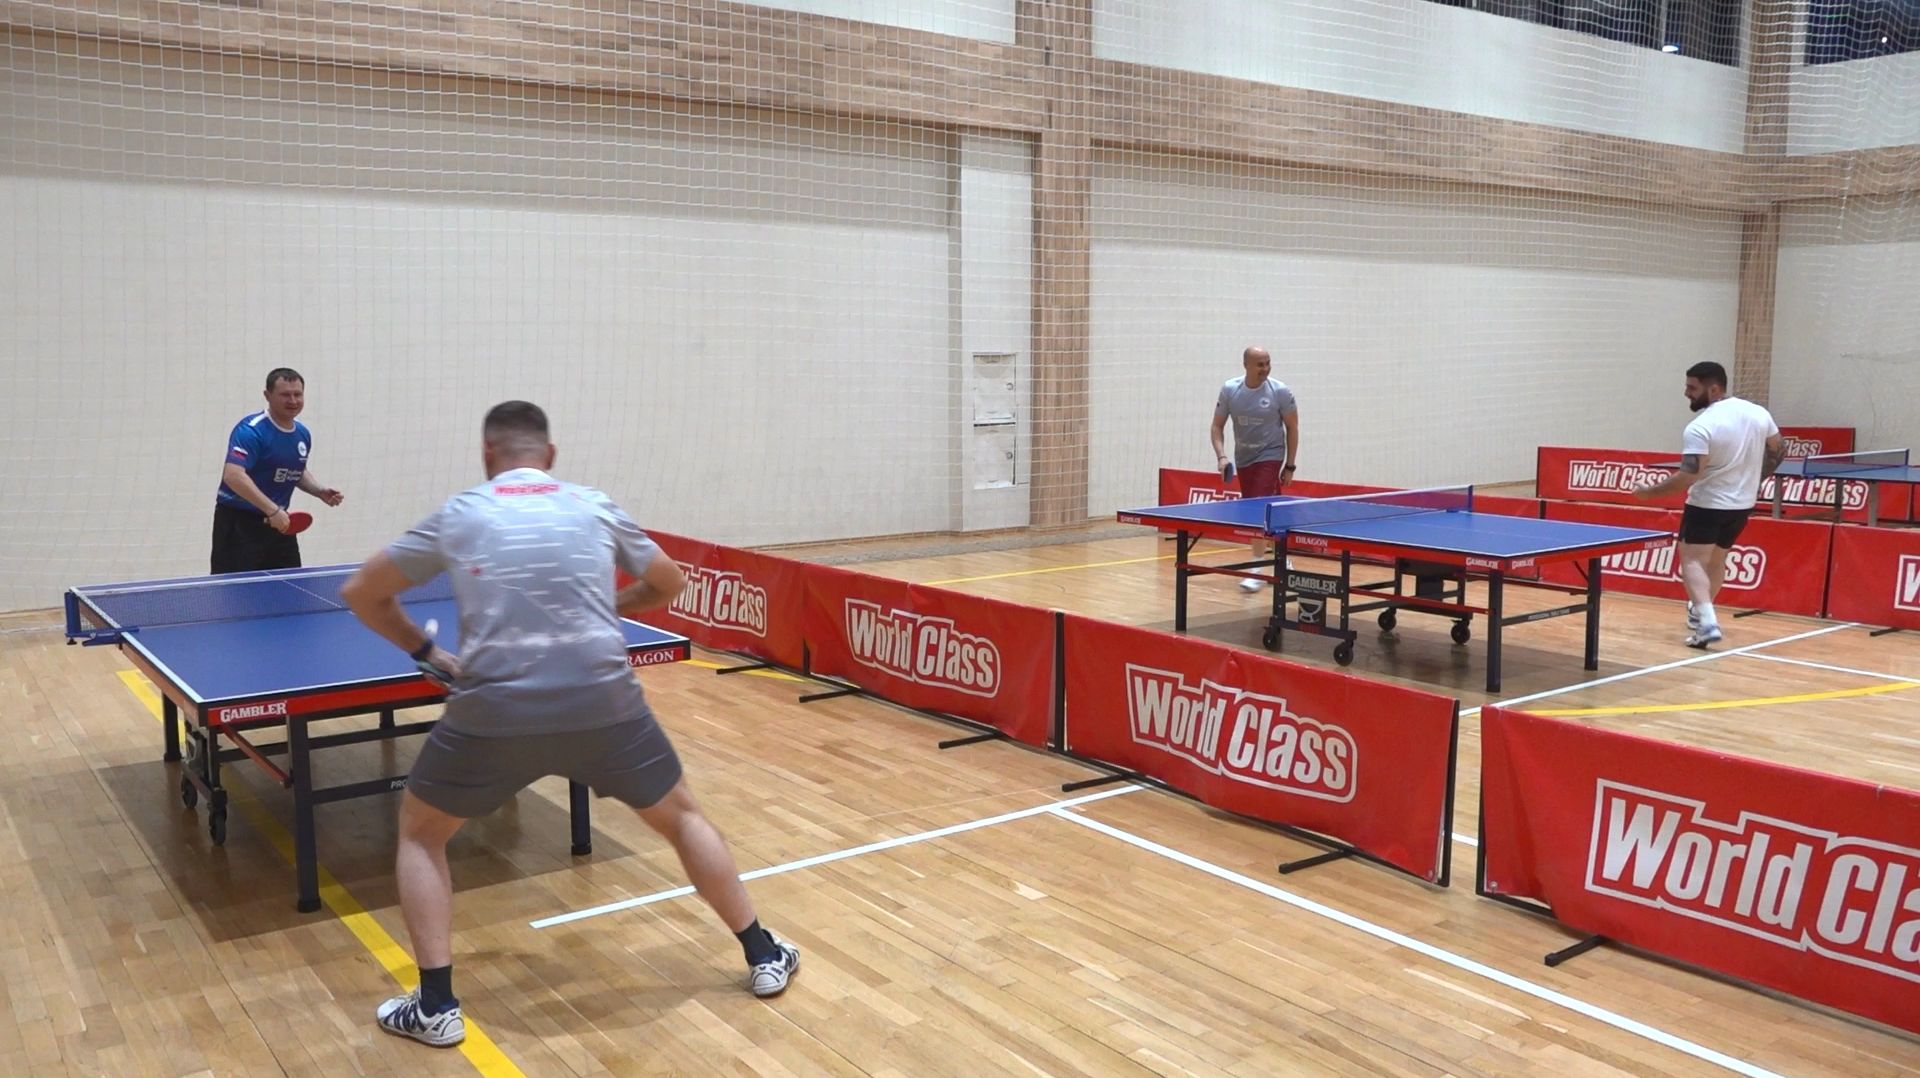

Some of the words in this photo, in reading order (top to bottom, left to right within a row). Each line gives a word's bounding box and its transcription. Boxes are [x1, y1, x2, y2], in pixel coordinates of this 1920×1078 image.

[1572, 464, 1620, 489] World
[1295, 535, 1328, 547] DRAGON
[1287, 574, 1337, 595] GAMBLER
[713, 578, 764, 630] Class
[626, 650, 674, 666] RAGON
[851, 607, 914, 672] World
[916, 625, 994, 688] Class
[220, 701, 288, 723] GAMBLER
[1134, 676, 1228, 761] World
[1227, 703, 1348, 790] Class
[1602, 797, 1813, 931] World
